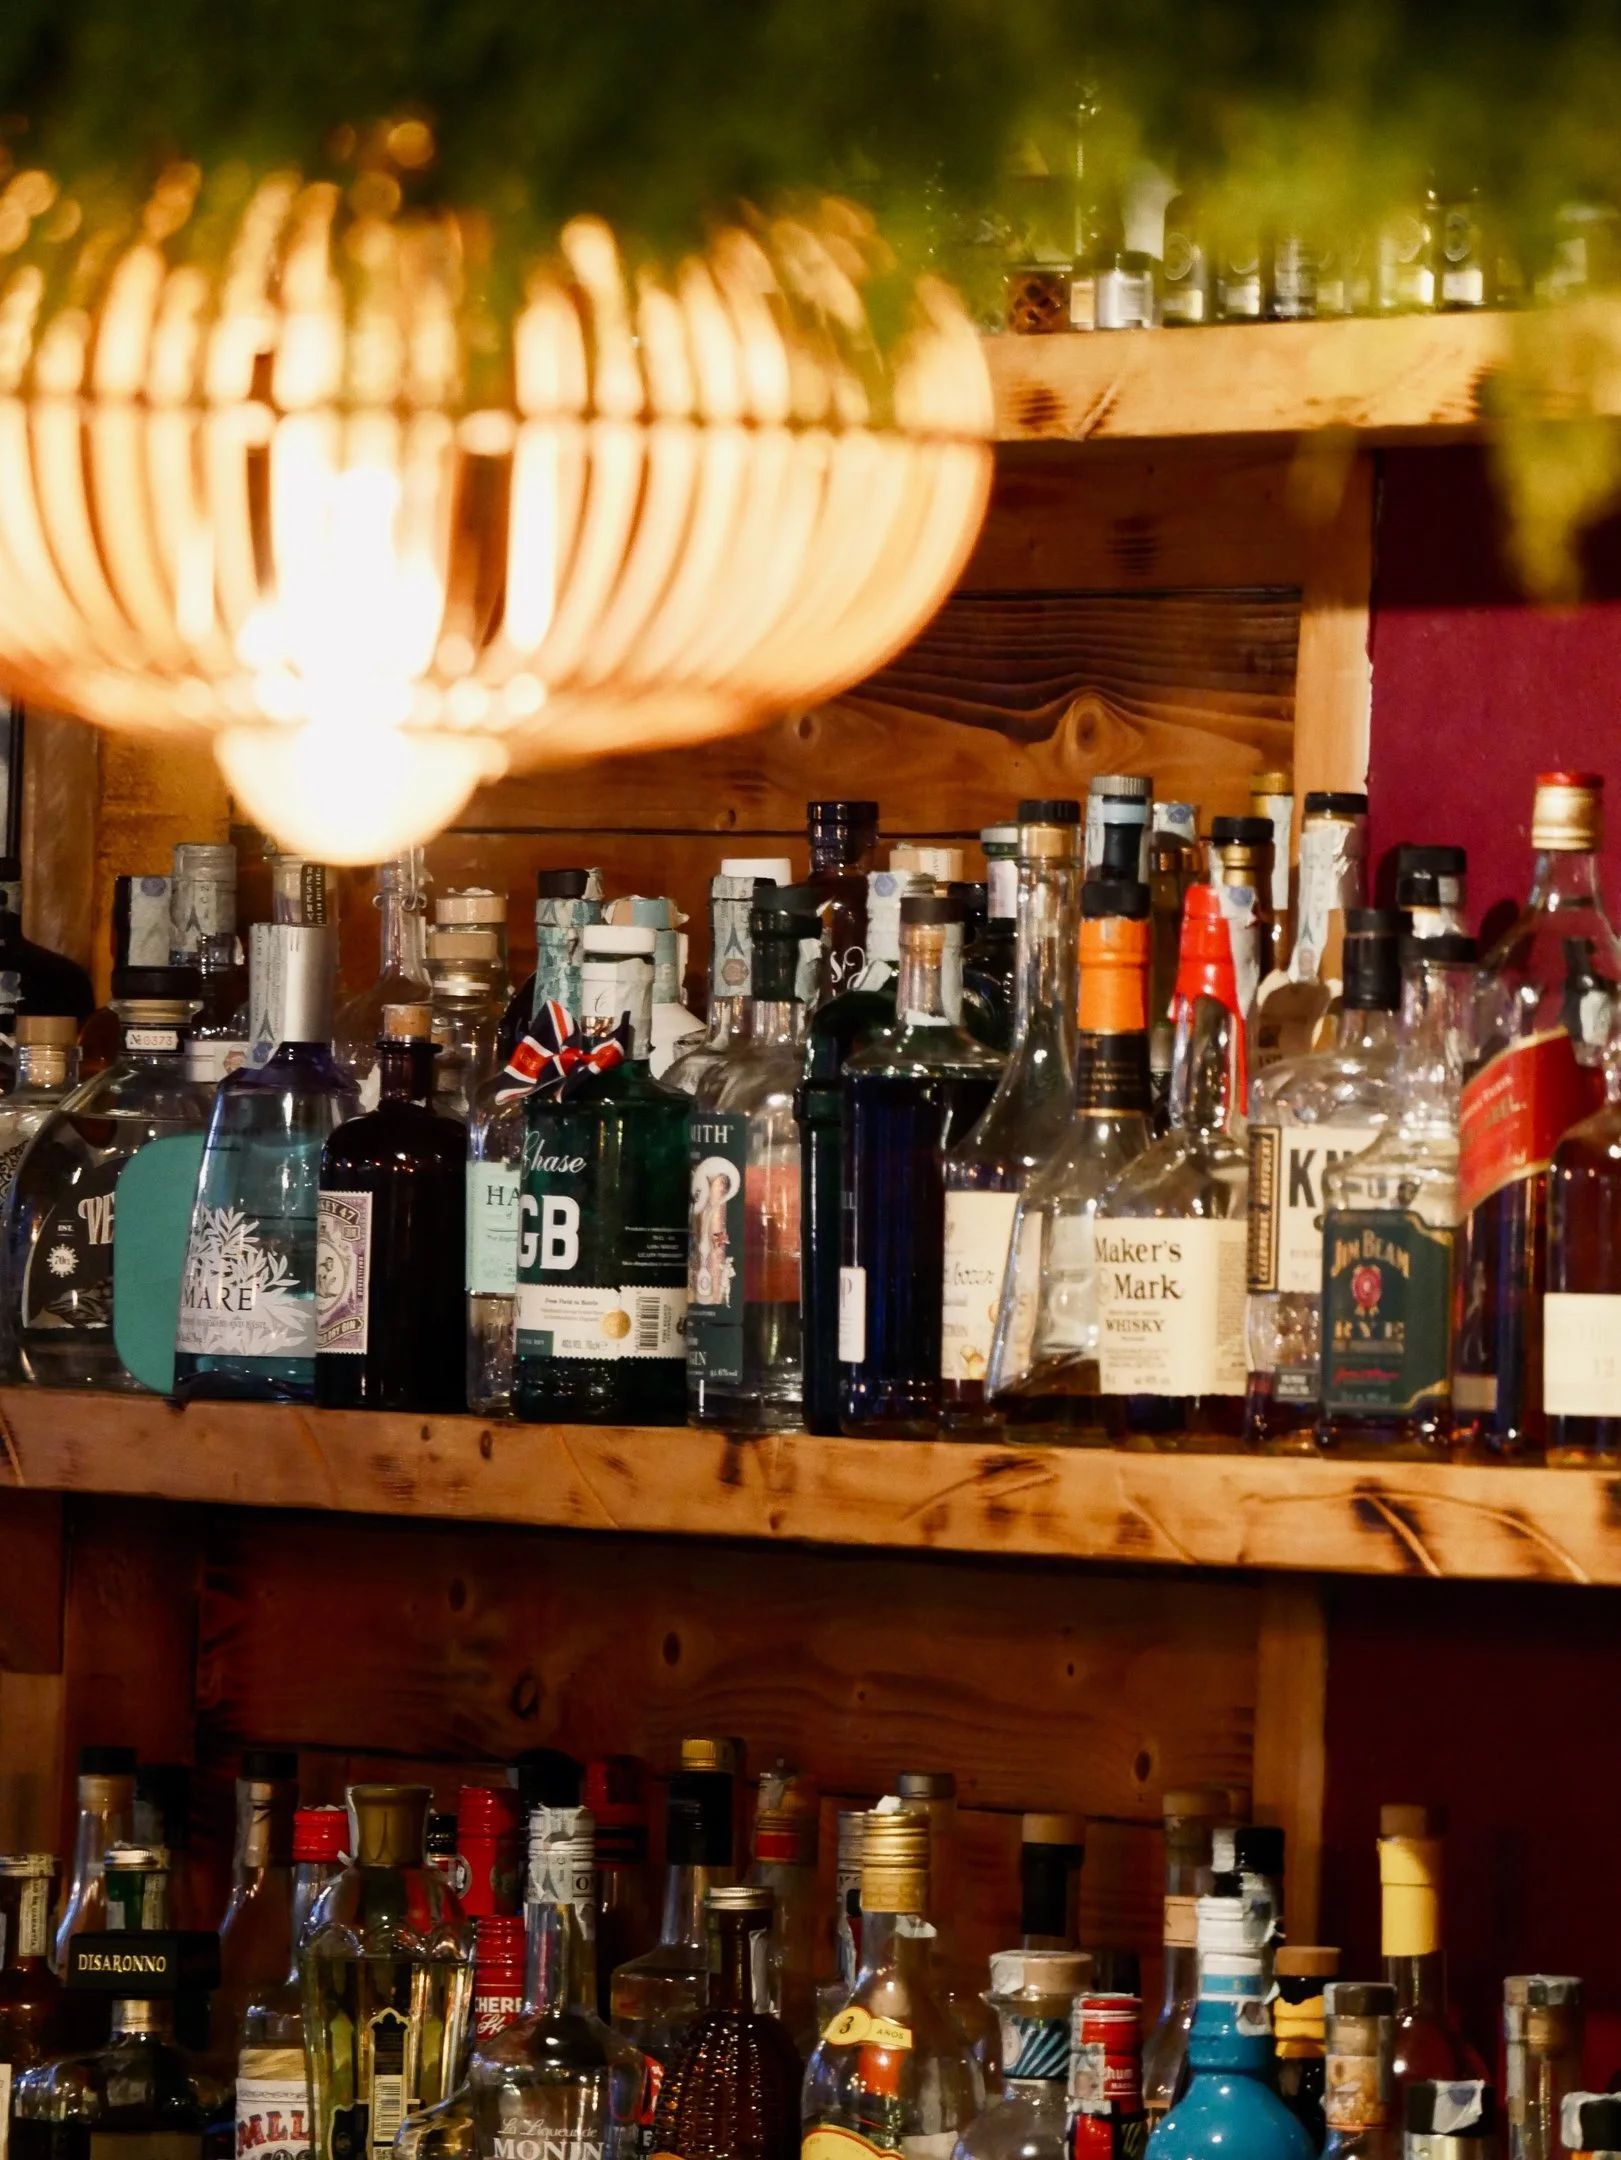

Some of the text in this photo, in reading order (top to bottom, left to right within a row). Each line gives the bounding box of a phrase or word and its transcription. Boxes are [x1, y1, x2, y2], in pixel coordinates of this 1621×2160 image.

[340, 1207, 357, 1221] 47
[517, 1194, 581, 1271] GB
[1094, 1236, 1183, 1264] Maker's
[1113, 1272, 1184, 1301] Mark
[182, 1285, 254, 1313] MARE
[1105, 1318, 1166, 1333] WHISKY
[78, 1954, 167, 1973] DISARONNO
[839, 2015, 855, 2035] 3
[493, 2137, 605, 2160] MONIN
